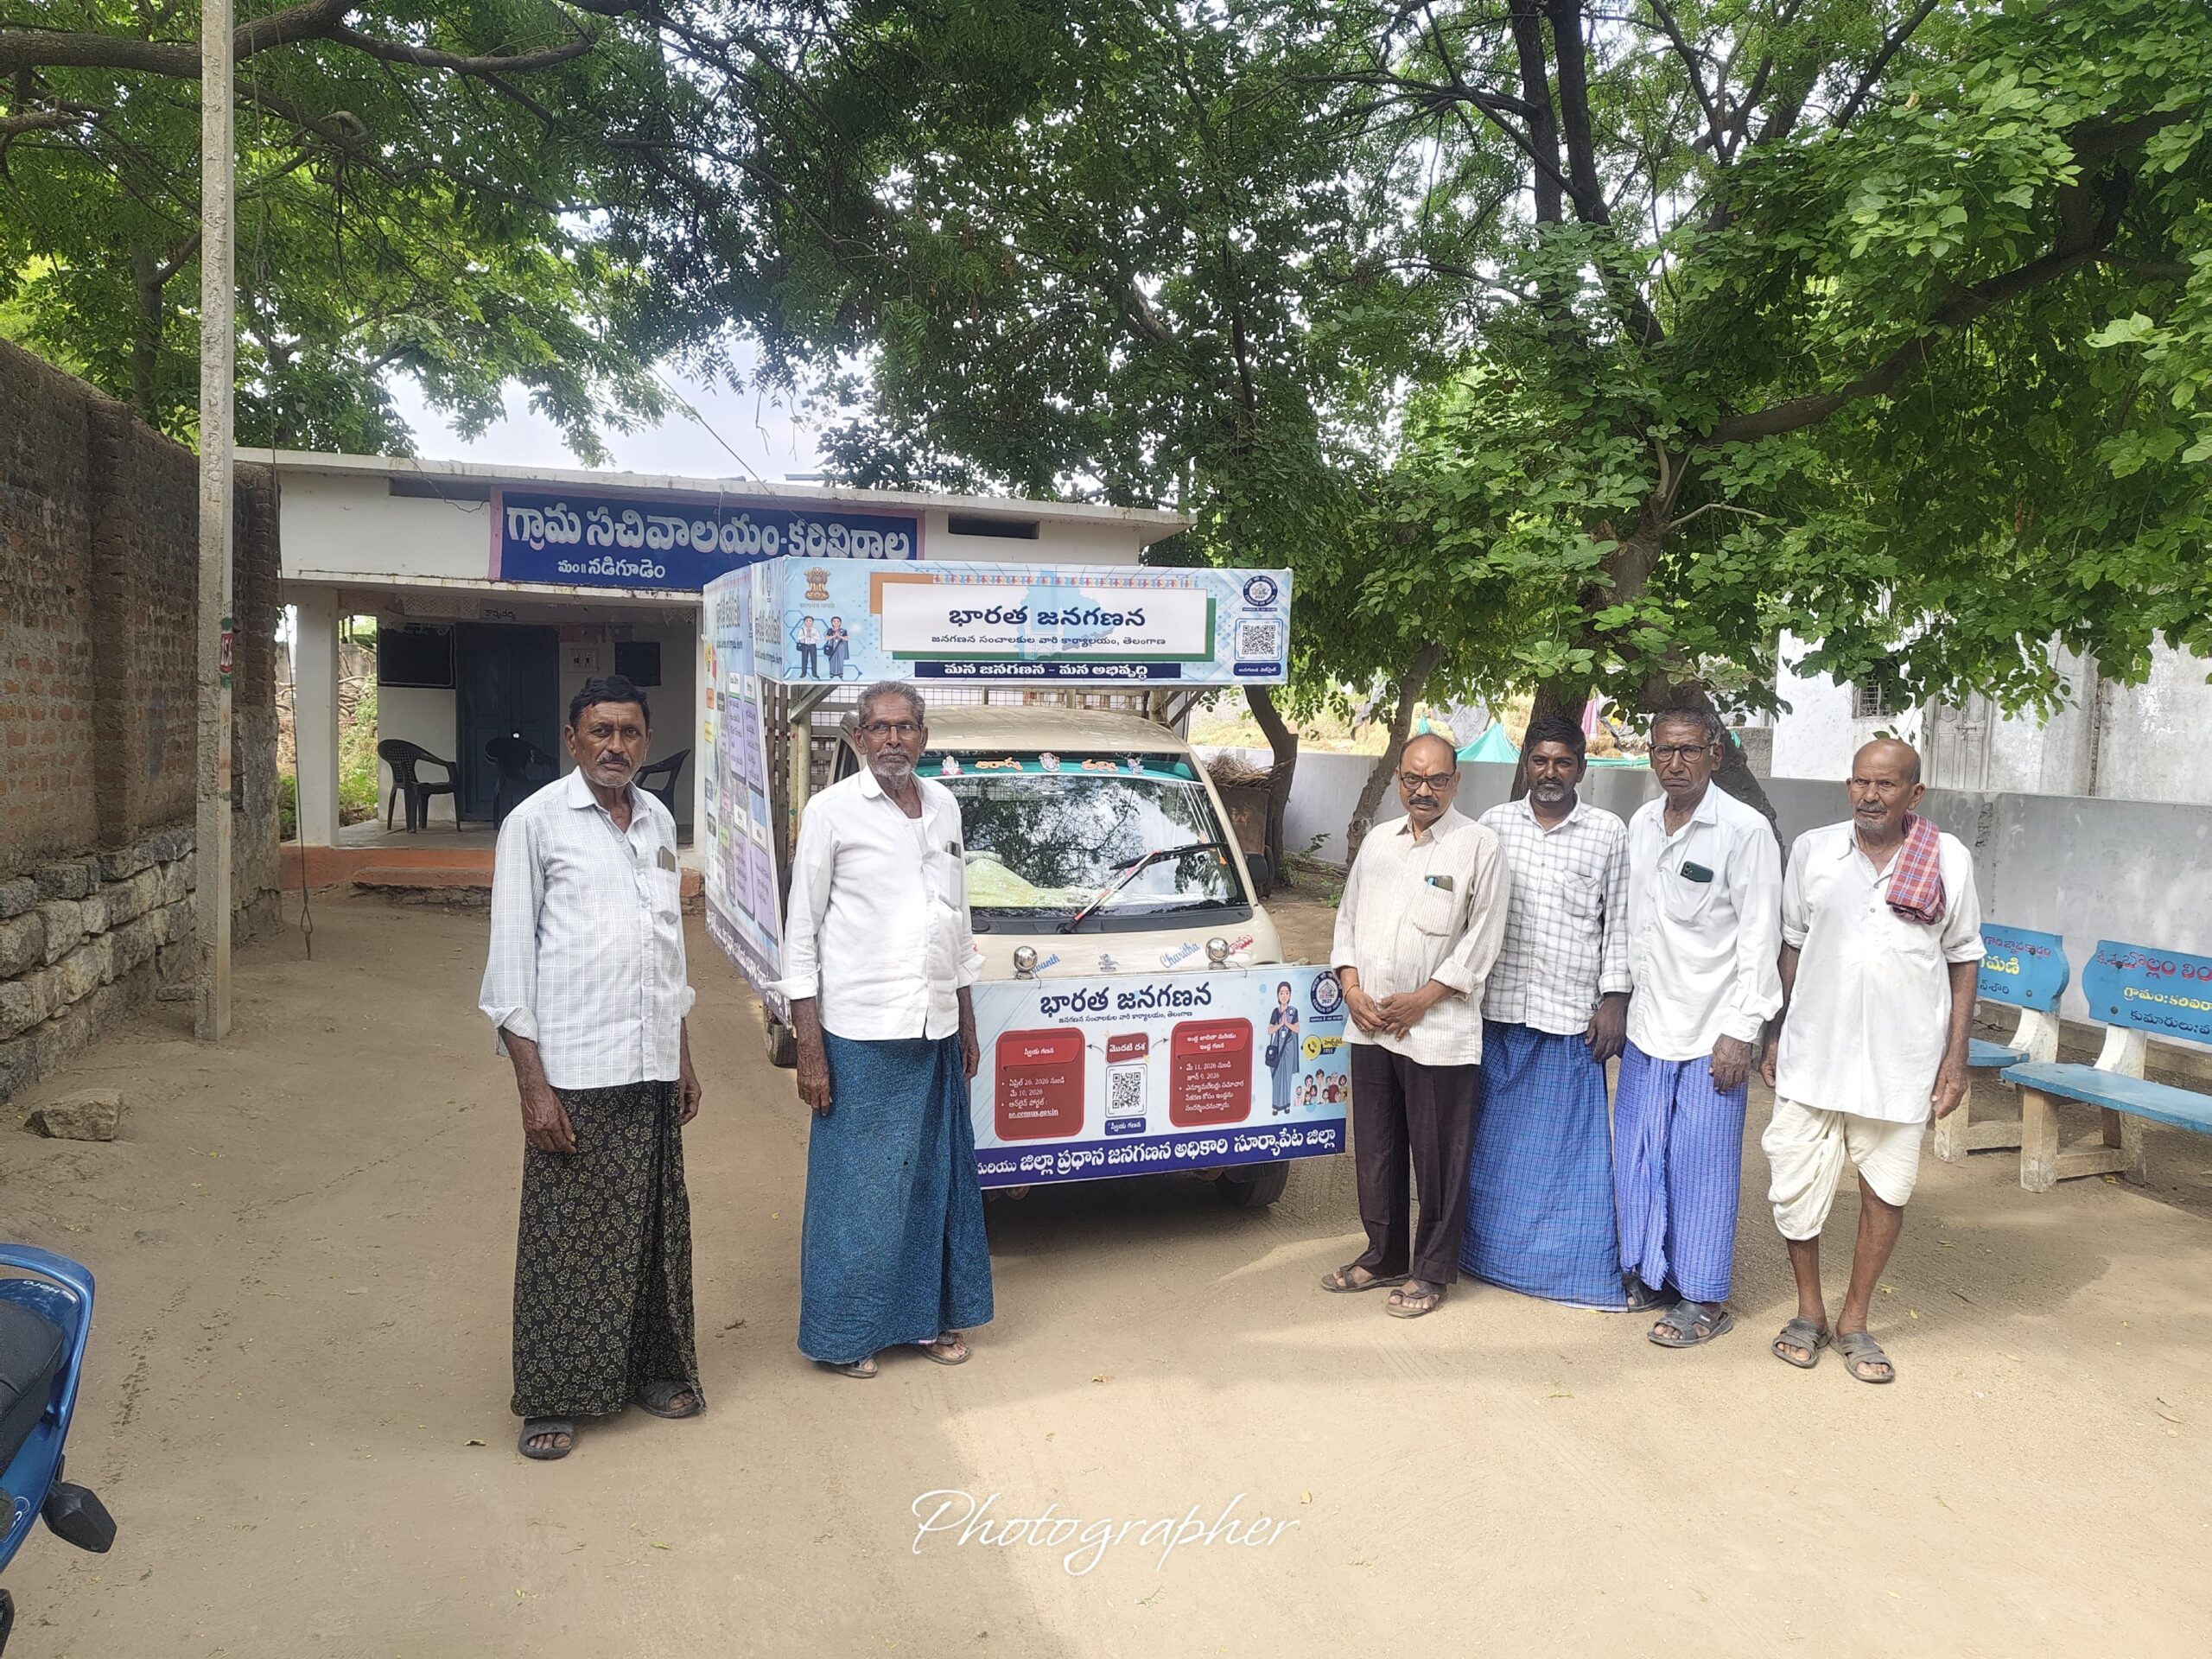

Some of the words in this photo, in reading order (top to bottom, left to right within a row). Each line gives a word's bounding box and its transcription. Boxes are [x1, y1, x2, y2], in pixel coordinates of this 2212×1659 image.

[506, 502, 582, 550] గ్రామ
[588, 556, 666, 579] నడిగూడెం
[949, 606, 1028, 626] భారత
[1037, 607, 1146, 626] జనగణన
[931, 634, 976, 644] జనగణన
[979, 635, 1035, 644] సంచాలకుల
[1039, 635, 1058, 644] వారి
[1122, 636, 1166, 645] తెలంగాణ
[944, 664, 976, 675] మన
[979, 664, 1046, 675] జనగణన
[1058, 664, 1089, 675] మన
[1092, 665, 1148, 681] అభివృద్ధి
[1160, 943, 1200, 969] Charitha
[1040, 986, 1109, 1018] భారత
[1117, 982, 1212, 1010] జనగణన
[1008, 1108, 1058, 1119] se.census.gov.in
[1020, 1154, 1053, 1176] జిల్లా
[1057, 1147, 1104, 1174] ప్రధాన
[1108, 1141, 1172, 1165] జనగణన
[1174, 1138, 1228, 1160] అధికారి
[1234, 1128, 1303, 1156] సూర్యాపేట
[1306, 1128, 1336, 1148] జిల్లా
